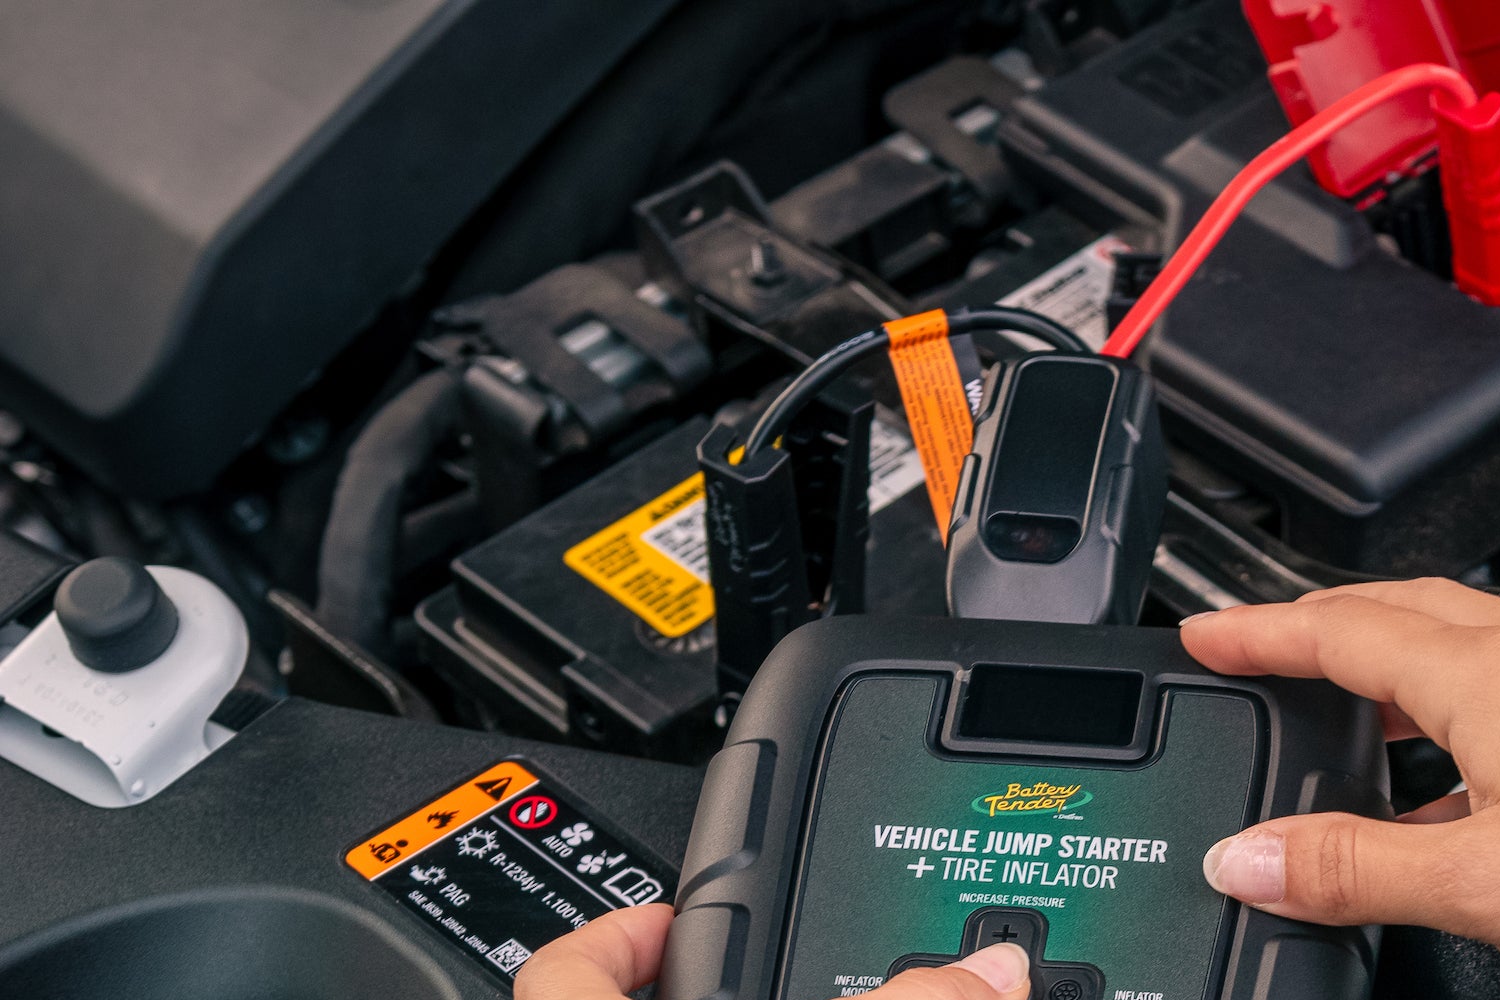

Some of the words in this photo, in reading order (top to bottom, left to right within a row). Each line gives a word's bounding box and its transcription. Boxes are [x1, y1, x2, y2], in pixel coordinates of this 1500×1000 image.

[1004, 782, 1081, 800] Battery
[984, 796, 1067, 818] Tender
[541, 835, 574, 858] AUTO
[874, 824, 979, 851] VEHICLE
[982, 831, 1053, 857] JUMP
[1058, 835, 1168, 863] STARTER
[941, 857, 996, 882] TIRE
[1002, 861, 1119, 889] INFLATOR
[439, 883, 470, 906] PAG
[489, 853, 546, 894] R-1234yf
[541, 890, 577, 918] 1.100
[959, 892, 1010, 905] INCREASE
[1011, 895, 1066, 908] PRESSURE
[834, 975, 883, 987] INFLATOR
